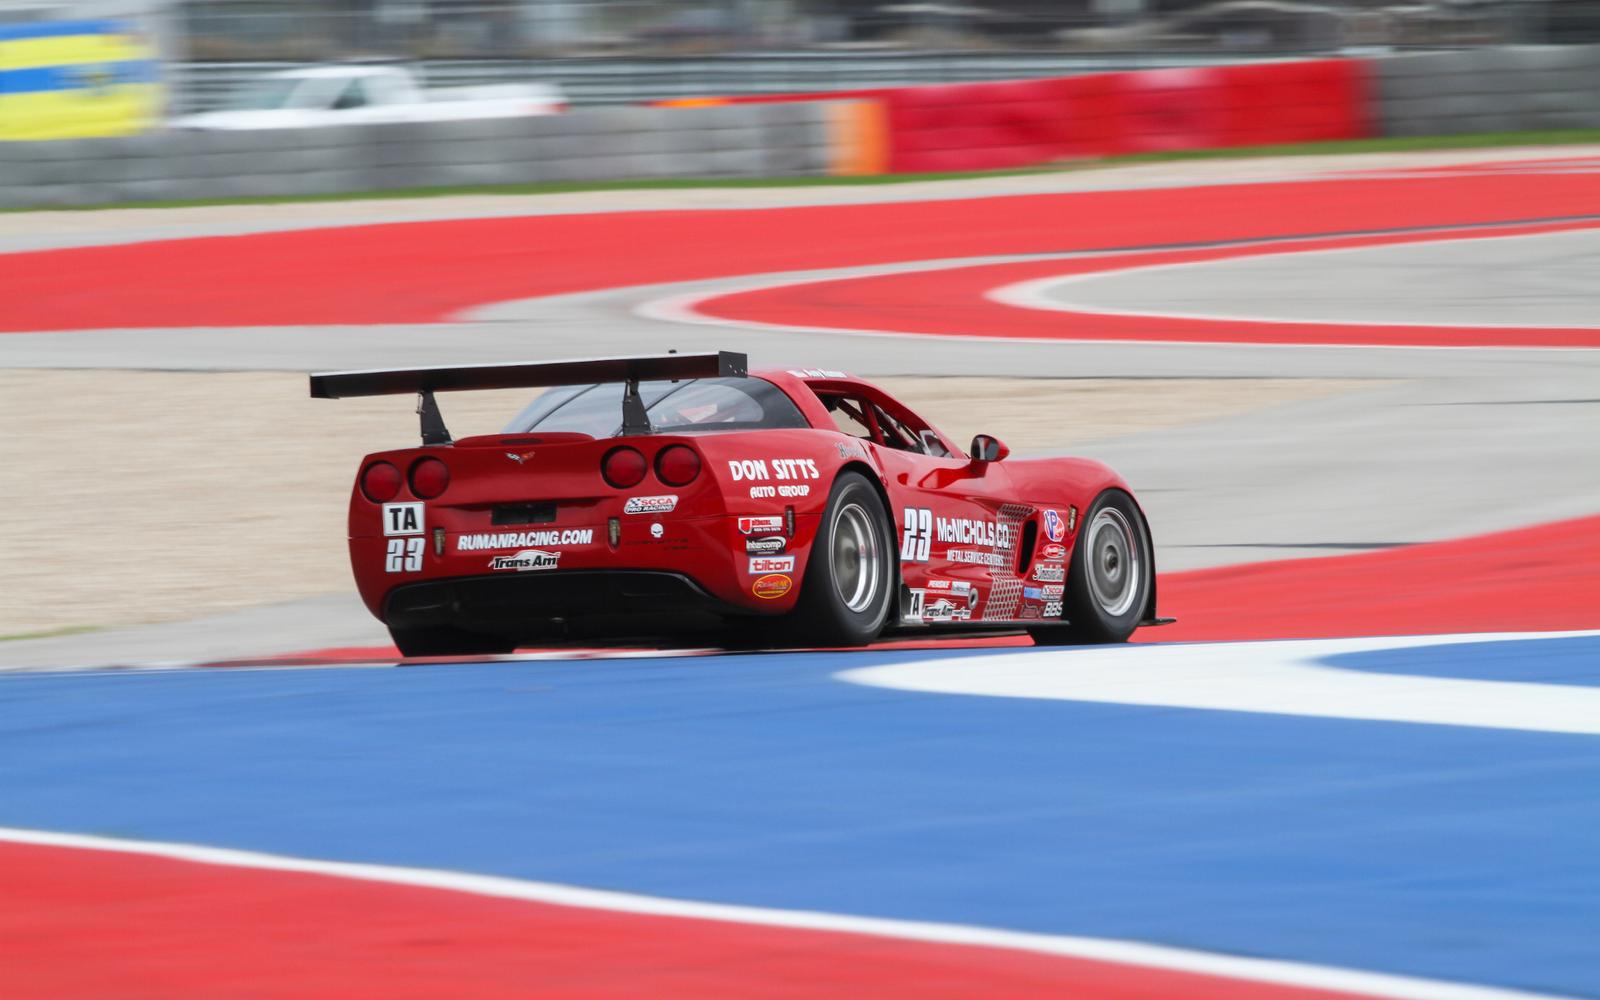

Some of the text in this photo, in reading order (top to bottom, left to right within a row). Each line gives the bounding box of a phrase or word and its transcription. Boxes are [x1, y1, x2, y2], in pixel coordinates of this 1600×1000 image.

[728, 458, 820, 481] DON SITTS
[750, 485, 810, 499] AUTO GROUP
[389, 507, 417, 531] TA
[457, 529, 594, 550] RUMANRACING.COM
[901, 508, 933, 562] 23
[936, 517, 995, 548] McNICHOLS
[385, 538, 425, 573] 23
[494, 555, 557, 569] Trans Am
[753, 560, 791, 571] tilton
[947, 549, 964, 562] METAL
[964, 551, 984, 565] SERVICE
